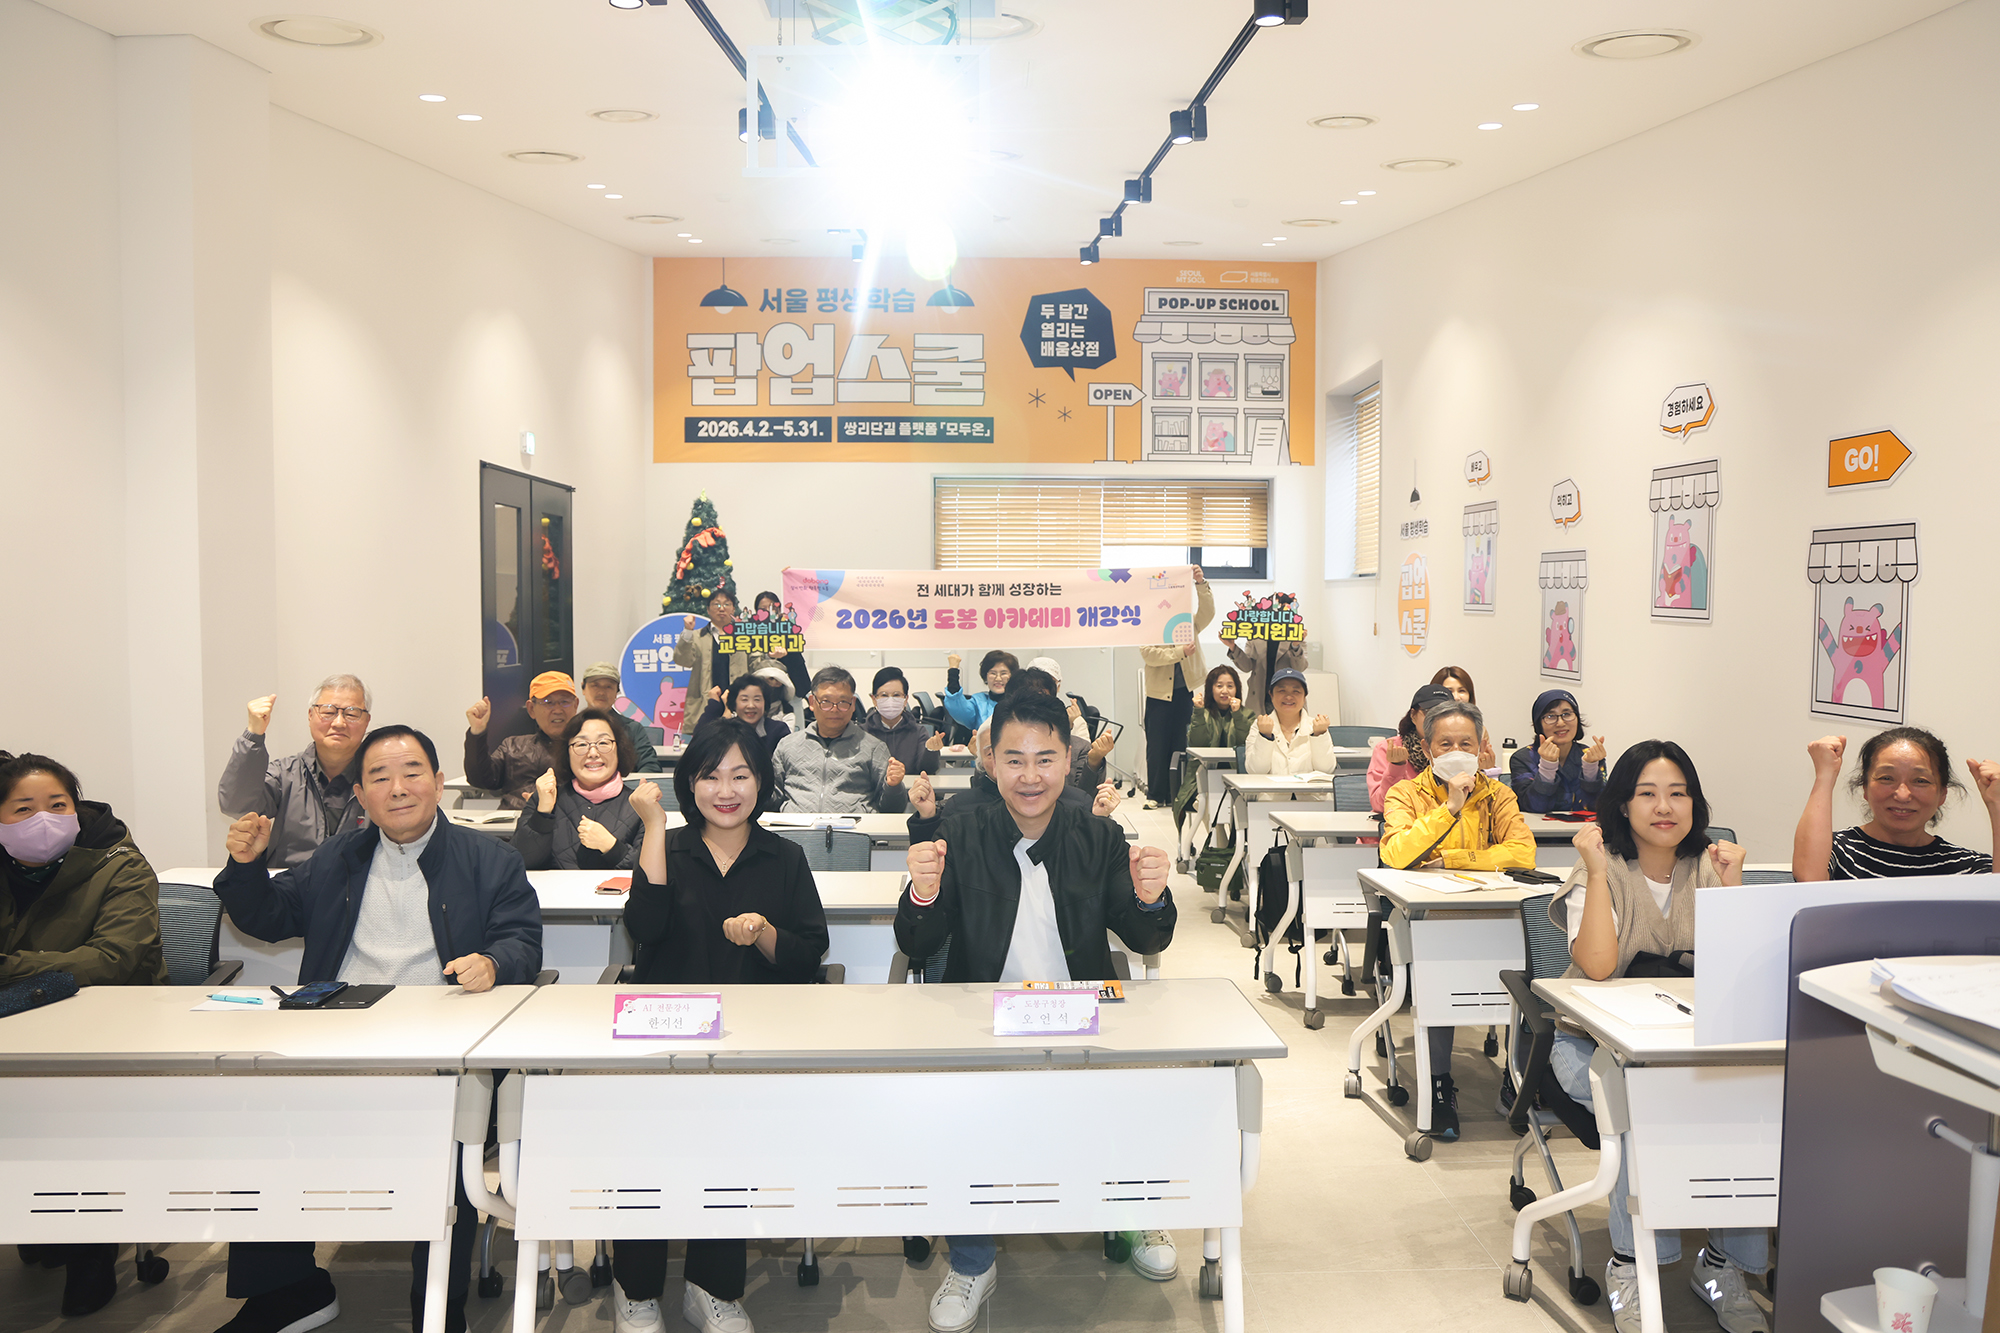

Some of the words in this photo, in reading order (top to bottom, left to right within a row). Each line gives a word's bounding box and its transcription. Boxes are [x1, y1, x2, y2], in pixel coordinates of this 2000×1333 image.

[758, 288, 808, 313] 서울
[816, 287, 916, 313] 평생학습
[1158, 297, 1216, 310] POP-UP
[1219, 299, 1279, 311] SCHOOL
[1040, 304, 1055, 319] 두
[1059, 304, 1089, 320] 달간
[1041, 323, 1085, 338] 열리는
[1041, 341, 1100, 357] 배움상점
[687, 322, 986, 406] 팝업스쿨
[1093, 389, 1132, 400] OPEN
[1667, 395, 1704, 418] 경험하세요
[844, 422, 896, 436] 쌍리단길
[899, 422, 937, 436] 플랫폼
[1844, 444, 1880, 473] GO!
[1401, 556, 1426, 600] 팝업
[917, 584, 930, 597] 전
[934, 584, 974, 597] 세대가
[978, 583, 1005, 597] 함께
[1009, 583, 1062, 596] 성장하는
[836, 608, 928, 630] 2026년
[934, 609, 978, 630] 도봉
[983, 606, 1071, 630] 아카데미
[1077, 605, 1142, 627] 개강식
[1237, 610, 1294, 623] 사랑합니다
[734, 622, 792, 635] 고맙습니다
[1221, 621, 1304, 641] 교육지원과
[1401, 608, 1426, 646] 스쿨
[653, 633, 672, 644] 서울
[718, 634, 806, 654] 교육지원과
[633, 645, 693, 673] 팝업
[643, 1004, 652, 1012] AI
[657, 1003, 690, 1012] 전문강사
[648, 1017, 683, 1029] 한지선
